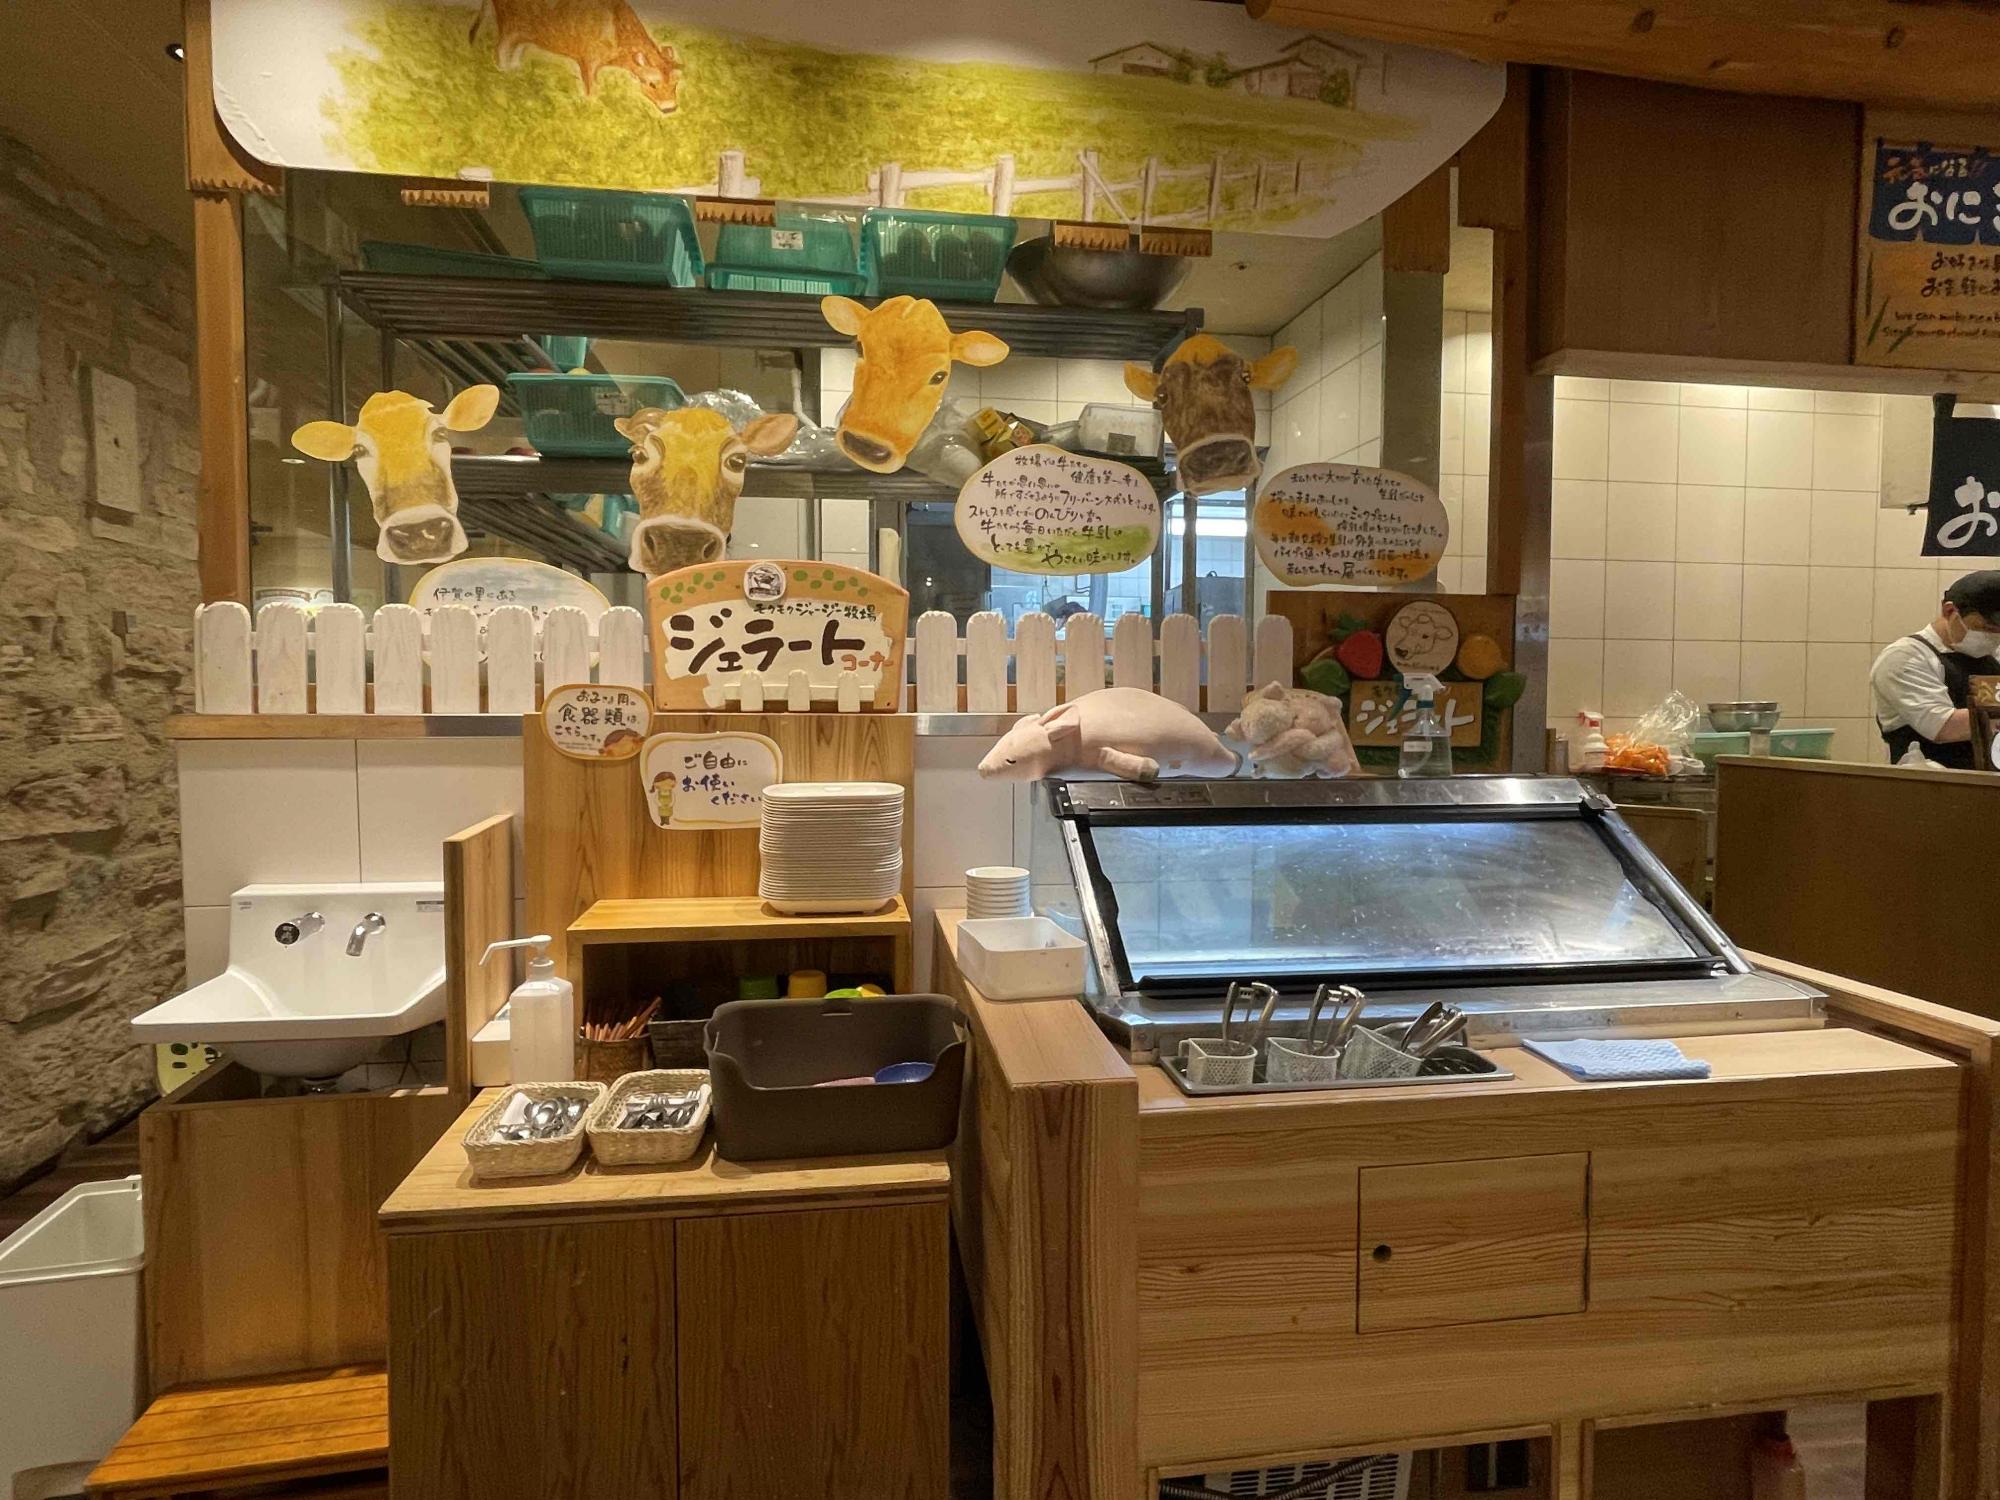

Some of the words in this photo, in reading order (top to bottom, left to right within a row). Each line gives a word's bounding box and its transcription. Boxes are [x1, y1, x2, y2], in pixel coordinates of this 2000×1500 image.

[753, 603, 877, 622] モクモクジャージー牧場
[669, 607, 866, 675] ジェラート
[840, 651, 894, 672] コーナー
[683, 751, 748, 770] ご自由に
[682, 775, 736, 793] お使い
